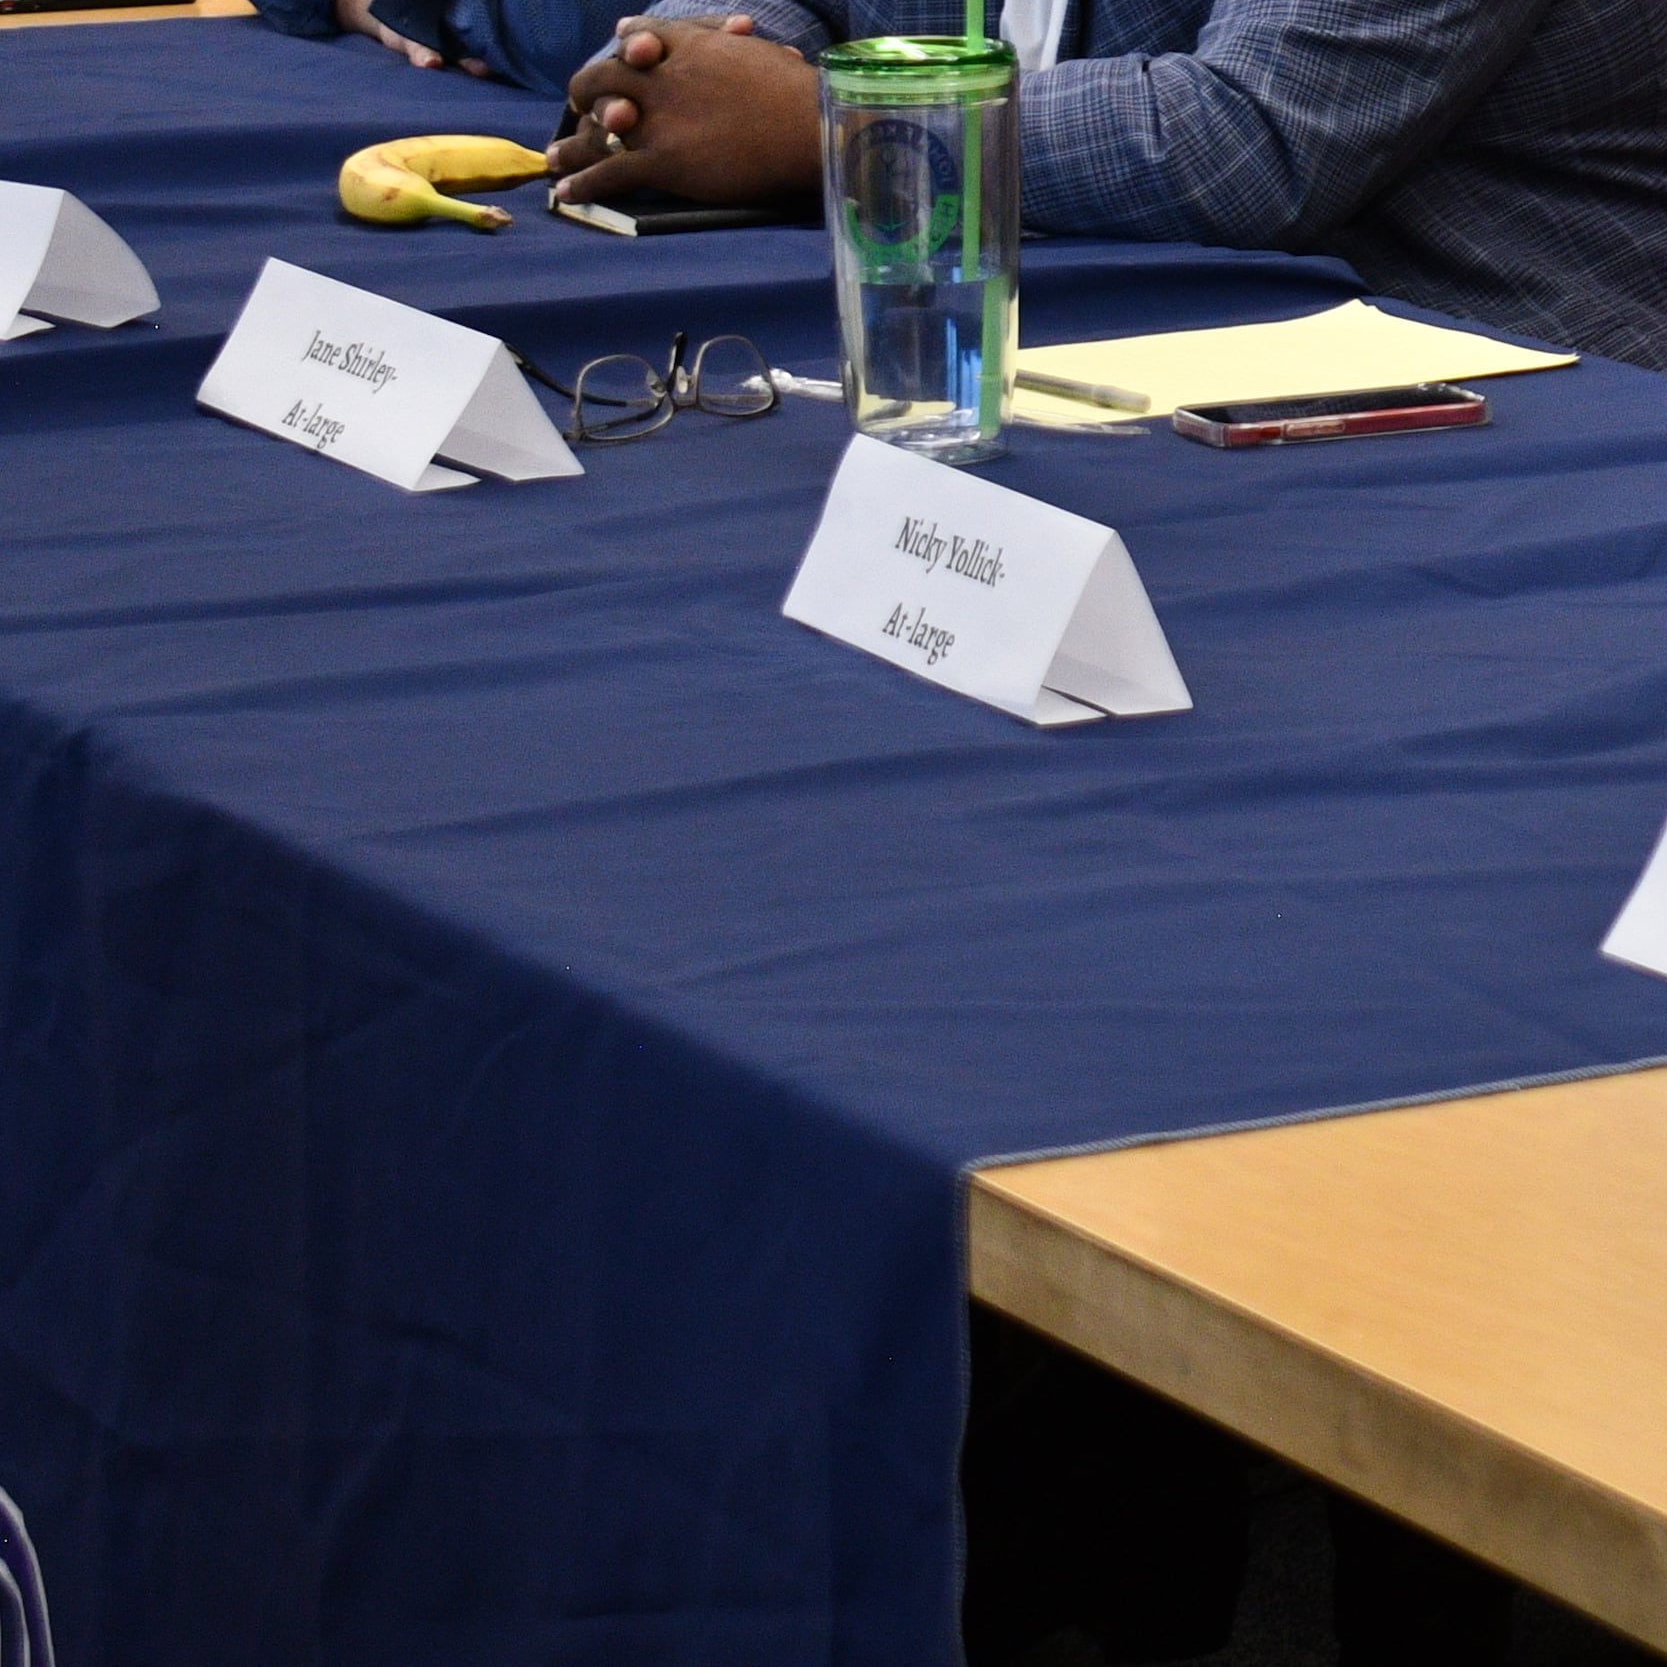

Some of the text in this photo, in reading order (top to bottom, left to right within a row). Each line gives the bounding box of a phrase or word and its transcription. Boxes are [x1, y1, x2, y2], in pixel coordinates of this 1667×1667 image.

[302, 329, 398, 394] Jane Shirley-
[281, 399, 345, 449] At-large
[895, 516, 1005, 588] Nicky Yollick-
[882, 602, 955, 665] At-large
